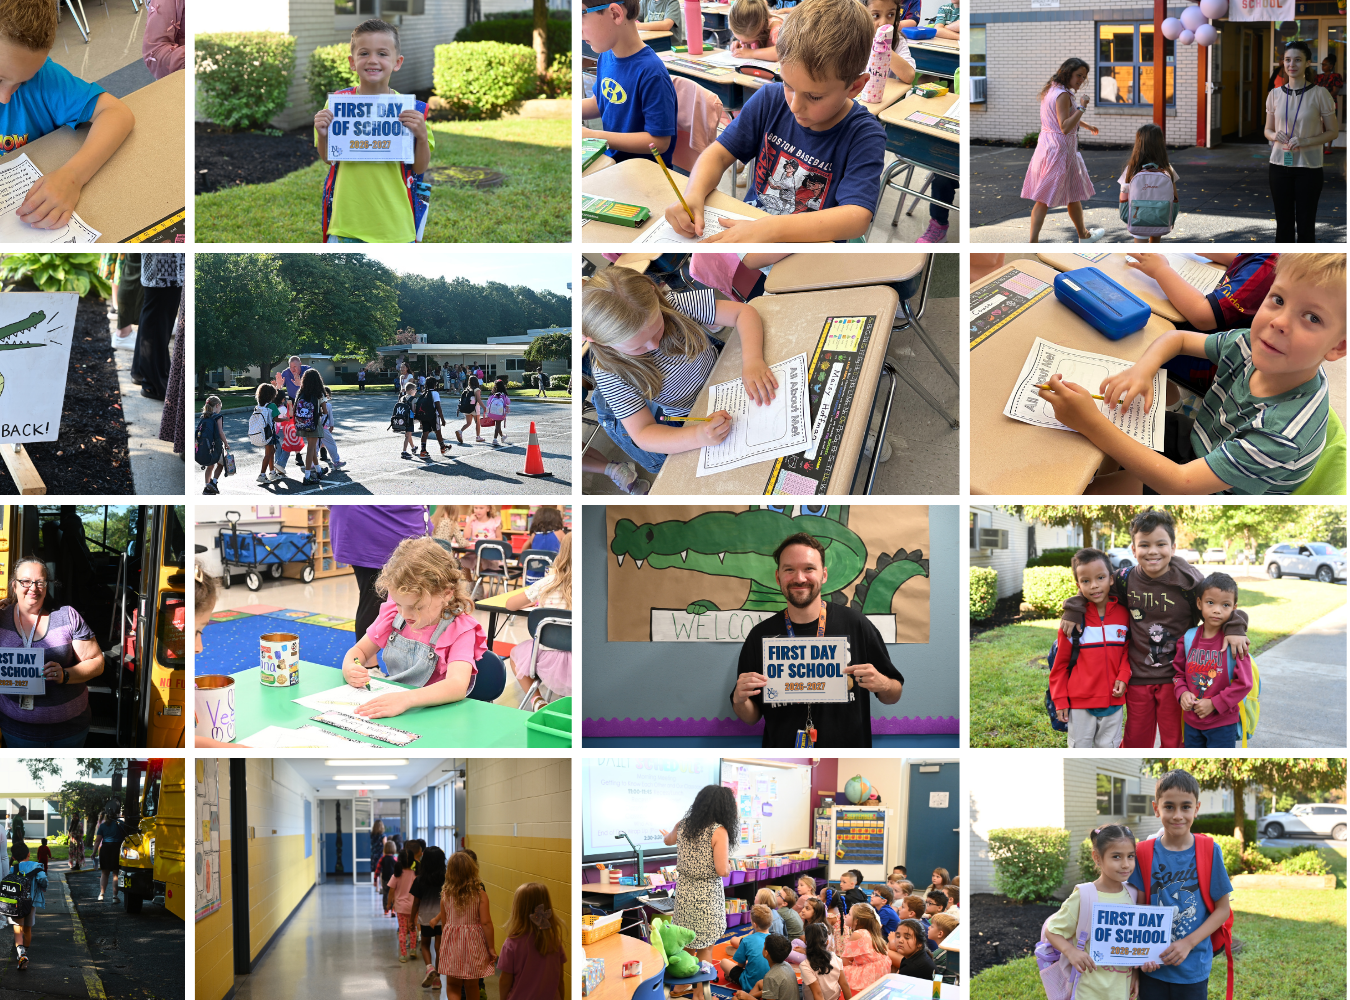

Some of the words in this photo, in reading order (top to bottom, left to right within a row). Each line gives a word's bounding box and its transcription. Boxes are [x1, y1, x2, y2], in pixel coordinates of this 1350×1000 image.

[1242, 0, 1283, 8] SCHOOL
[334, 103, 373, 117] FIRST
[377, 103, 403, 118] DAY
[332, 120, 349, 136] OF
[354, 121, 409, 136] SCHOOL
[350, 140, 391, 149] 2026-2027
[768, 133, 796, 154] BOSTON
[796, 149, 833, 171] BASEBALL
[790, 368, 798, 380] All
[1031, 366, 1049, 395] Aout
[824, 370, 840, 397] Maisy
[790, 382, 799, 413] About
[1024, 396, 1039, 412] All
[790, 415, 800, 437] Me!
[812, 403, 830, 441] Hoffman
[2, 422, 49, 438] BACK!
[672, 613, 762, 640] WELCO
[17, 653, 36, 665] DAY
[769, 646, 806, 660] FIRST
[811, 645, 837, 660] DAY
[1, 666, 41, 678] SCHOOL
[767, 664, 784, 678] OF
[788, 663, 843, 678] SCHOOL
[160, 678, 171, 687] NO
[785, 682, 825, 691] 2026-2027
[601, 779, 620, 787] Getting
[1152, 863, 1197, 884] Sonic
[2, 884, 16, 892] FILA
[124, 877, 132, 888] 34
[1098, 910, 1135, 926] FIRST
[1138, 913, 1164, 927] DAY
[1095, 927, 1112, 942] OF
[1115, 928, 1167, 944] SCHOOL
[1111, 946, 1150, 956] 2026-2027
